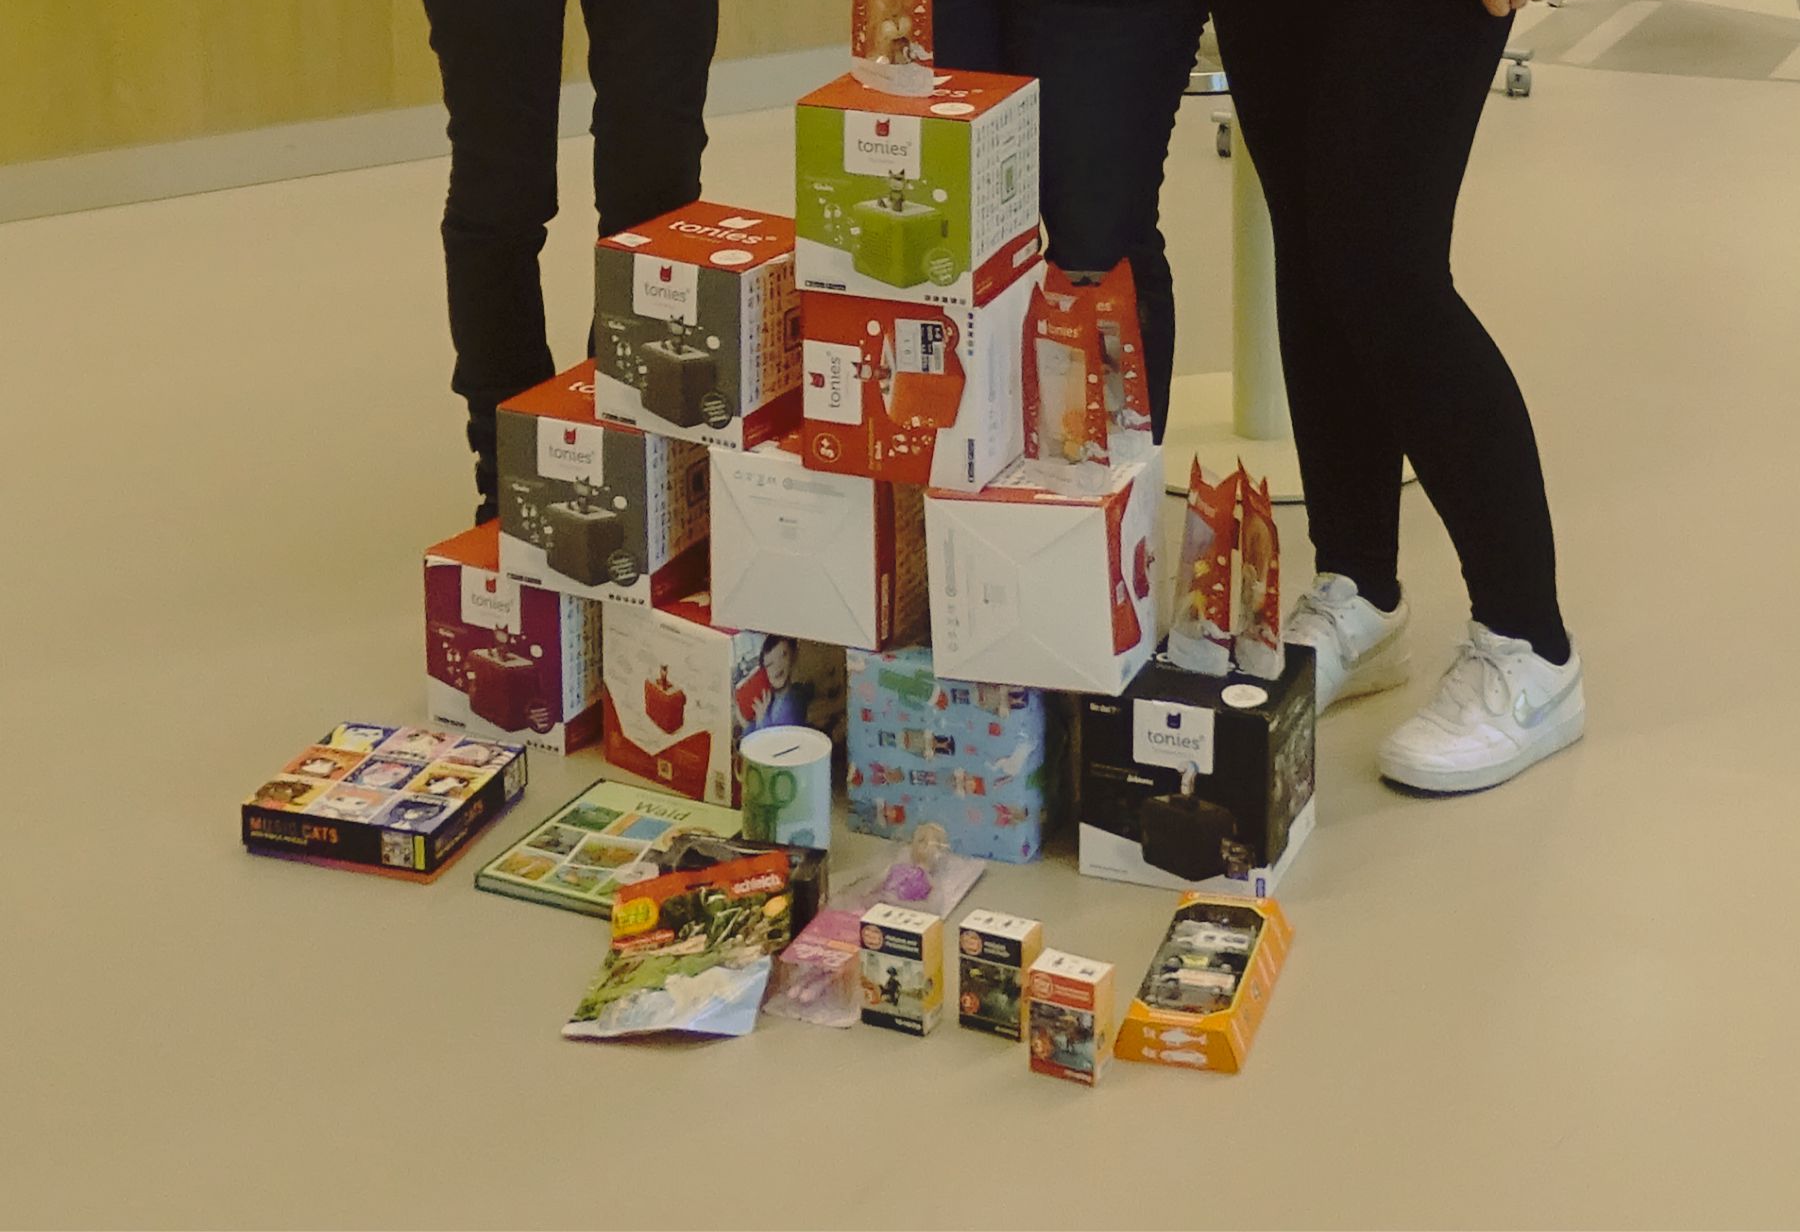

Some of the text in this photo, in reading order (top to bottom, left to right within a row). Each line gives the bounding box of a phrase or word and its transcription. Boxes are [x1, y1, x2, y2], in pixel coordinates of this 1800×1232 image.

[857, 137, 910, 157] tonies
[1147, 730, 1200, 750] tonies
[634, 800, 692, 821] Wald
